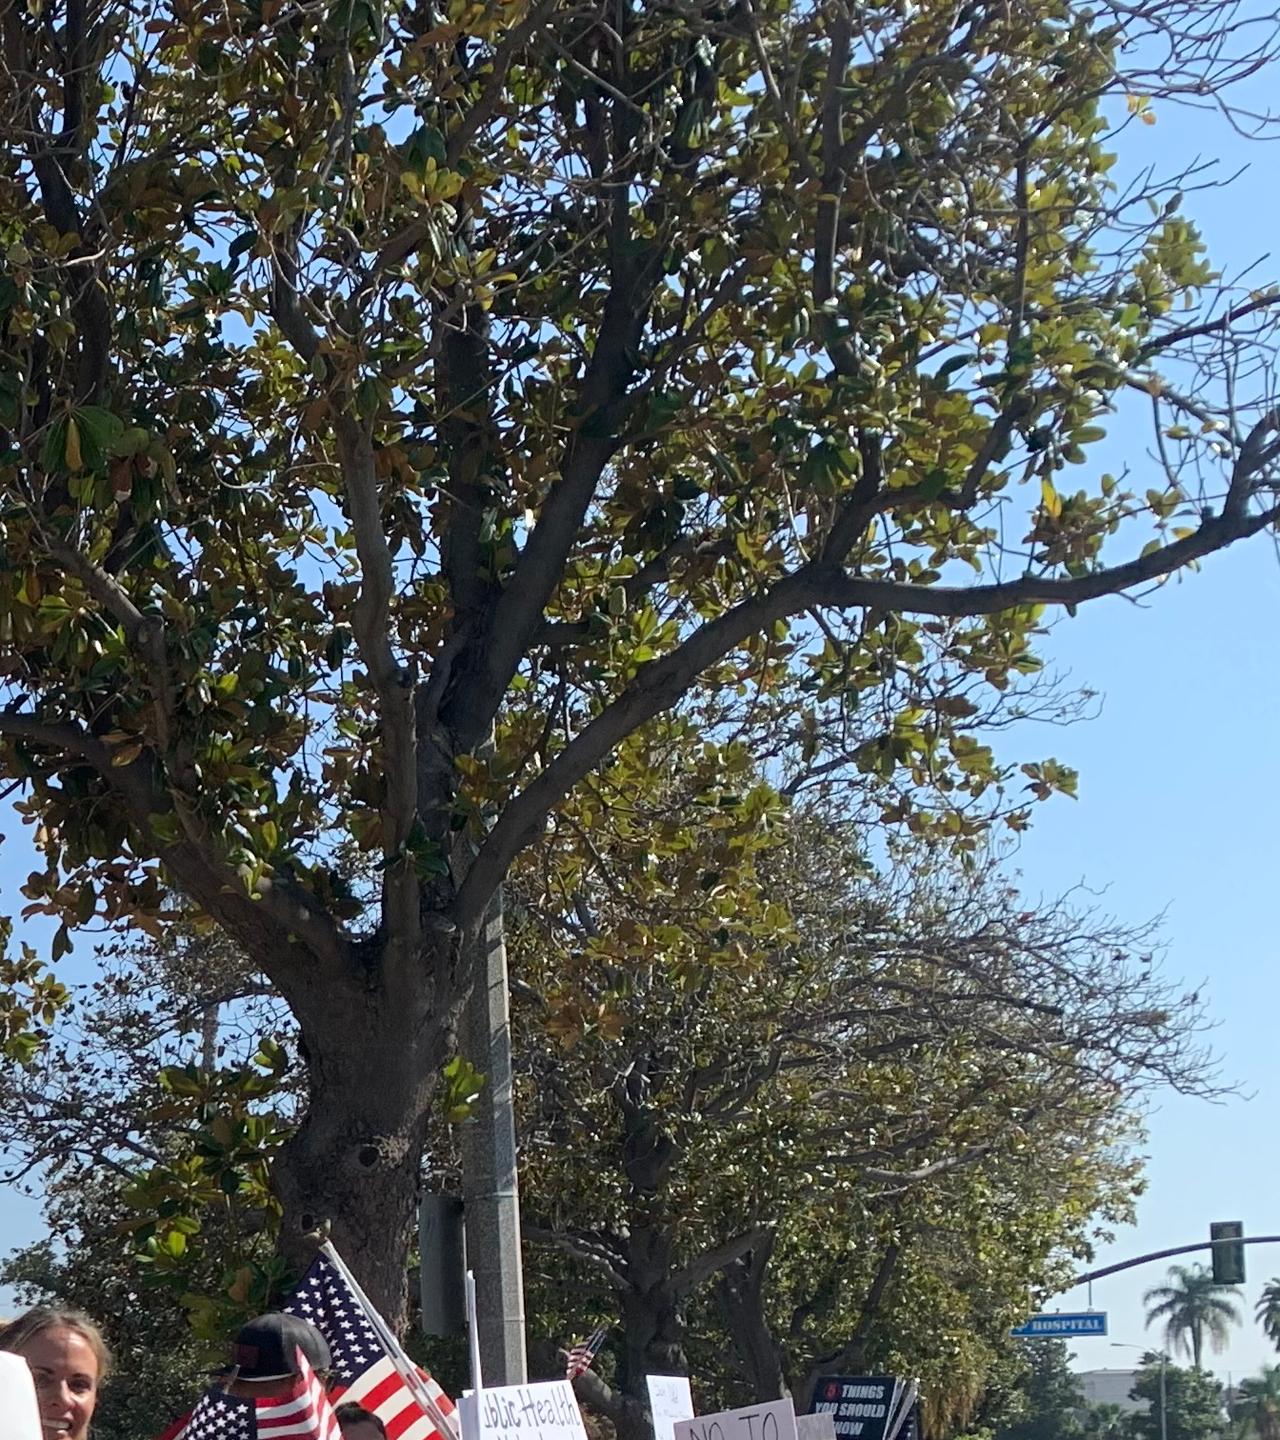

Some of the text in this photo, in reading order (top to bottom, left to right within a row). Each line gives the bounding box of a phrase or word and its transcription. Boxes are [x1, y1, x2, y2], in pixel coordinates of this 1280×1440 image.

[1032, 1319, 1102, 1331] HOSPITAL
[841, 1384, 885, 1399] THINGS
[518, 1384, 580, 1428] Health
[815, 1402, 886, 1418] YOU SHOULD
[834, 1421, 864, 1436] NOW
